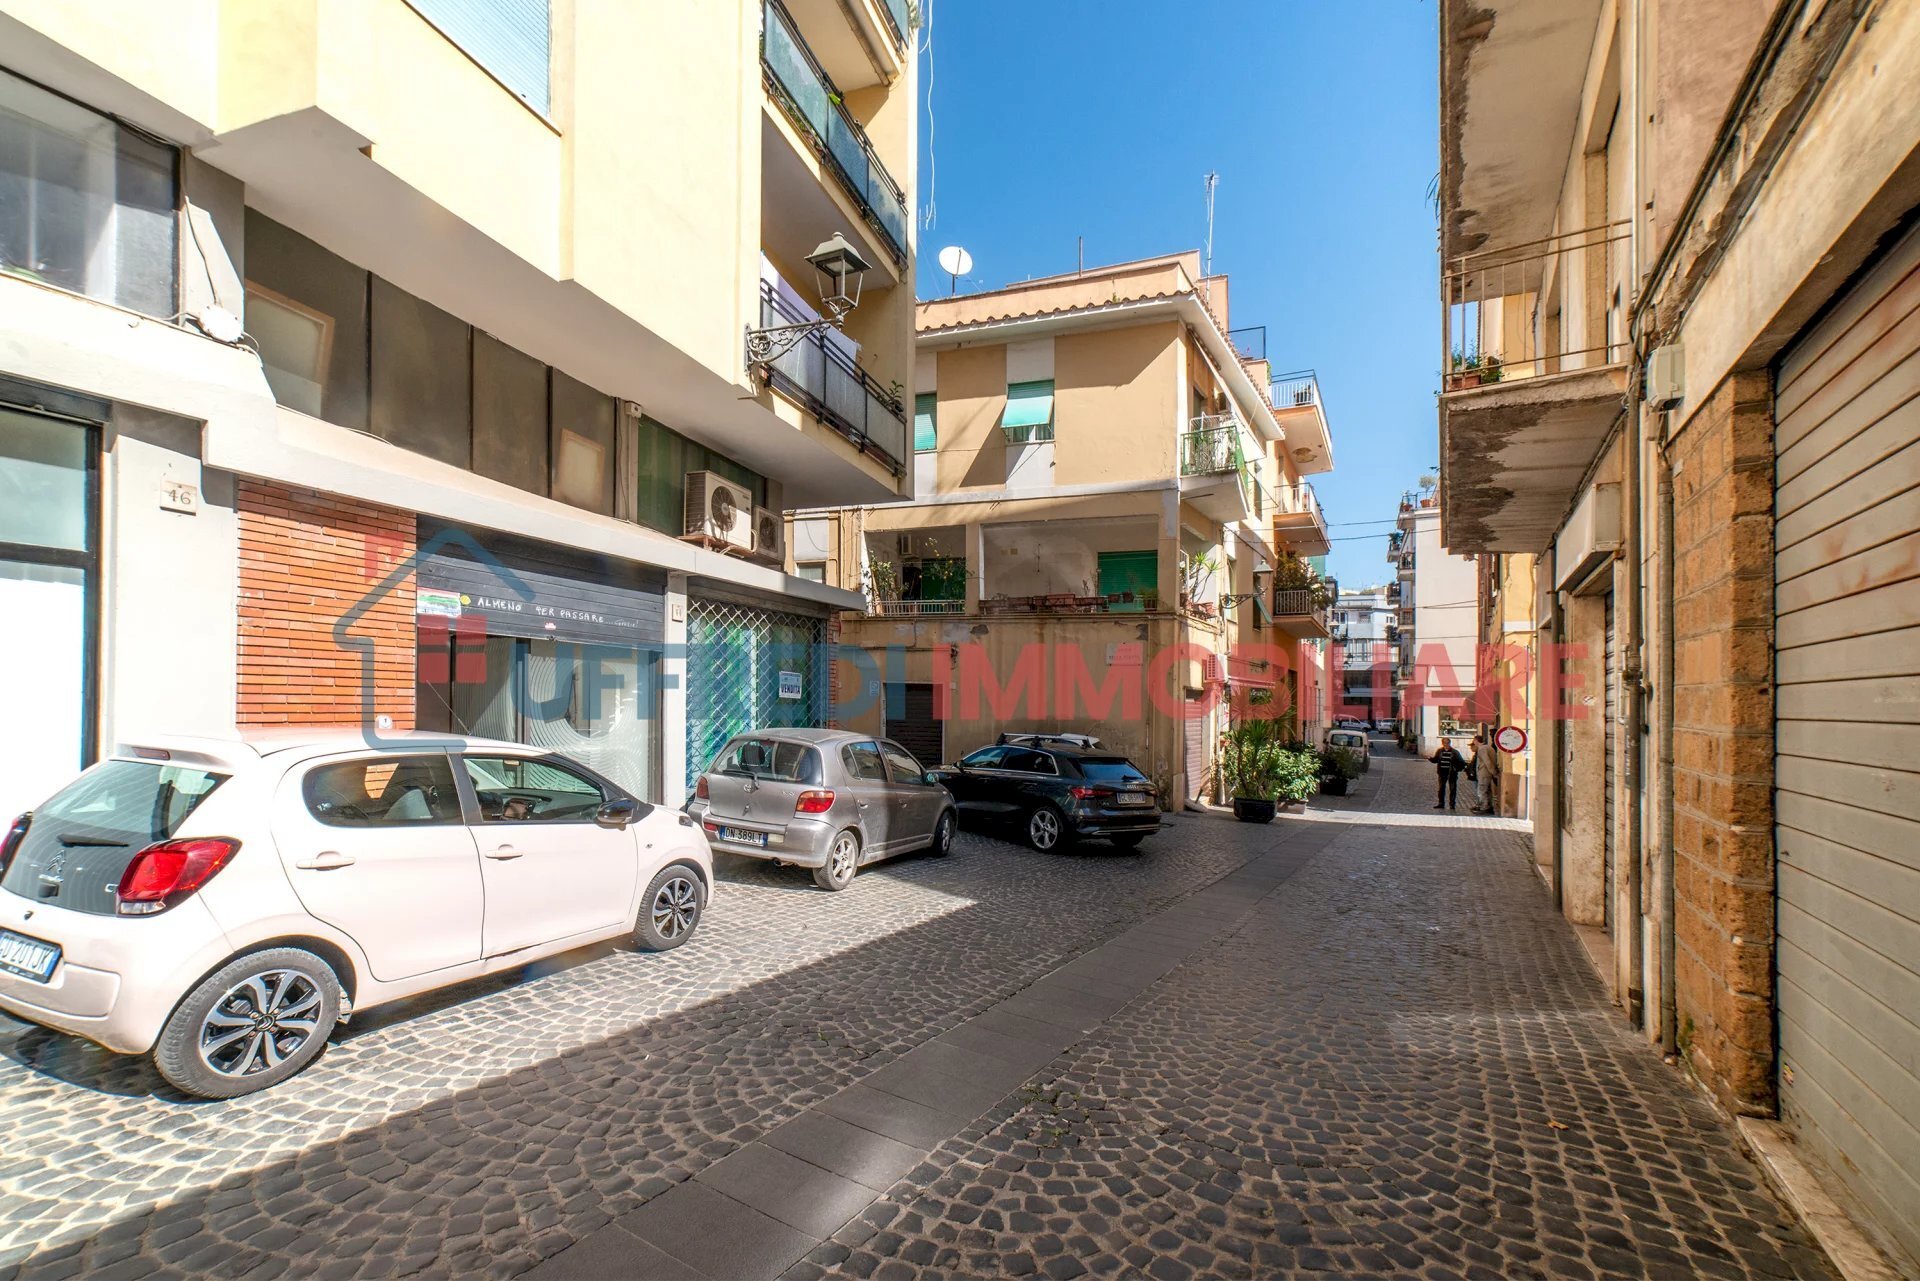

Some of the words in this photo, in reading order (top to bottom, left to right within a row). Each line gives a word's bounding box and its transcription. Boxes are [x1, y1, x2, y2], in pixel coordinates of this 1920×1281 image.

[168, 489, 191, 505] 46
[477, 597, 522, 612] ALMENO
[536, 605, 555, 617] PER
[781, 683, 801, 695] VENDITA
